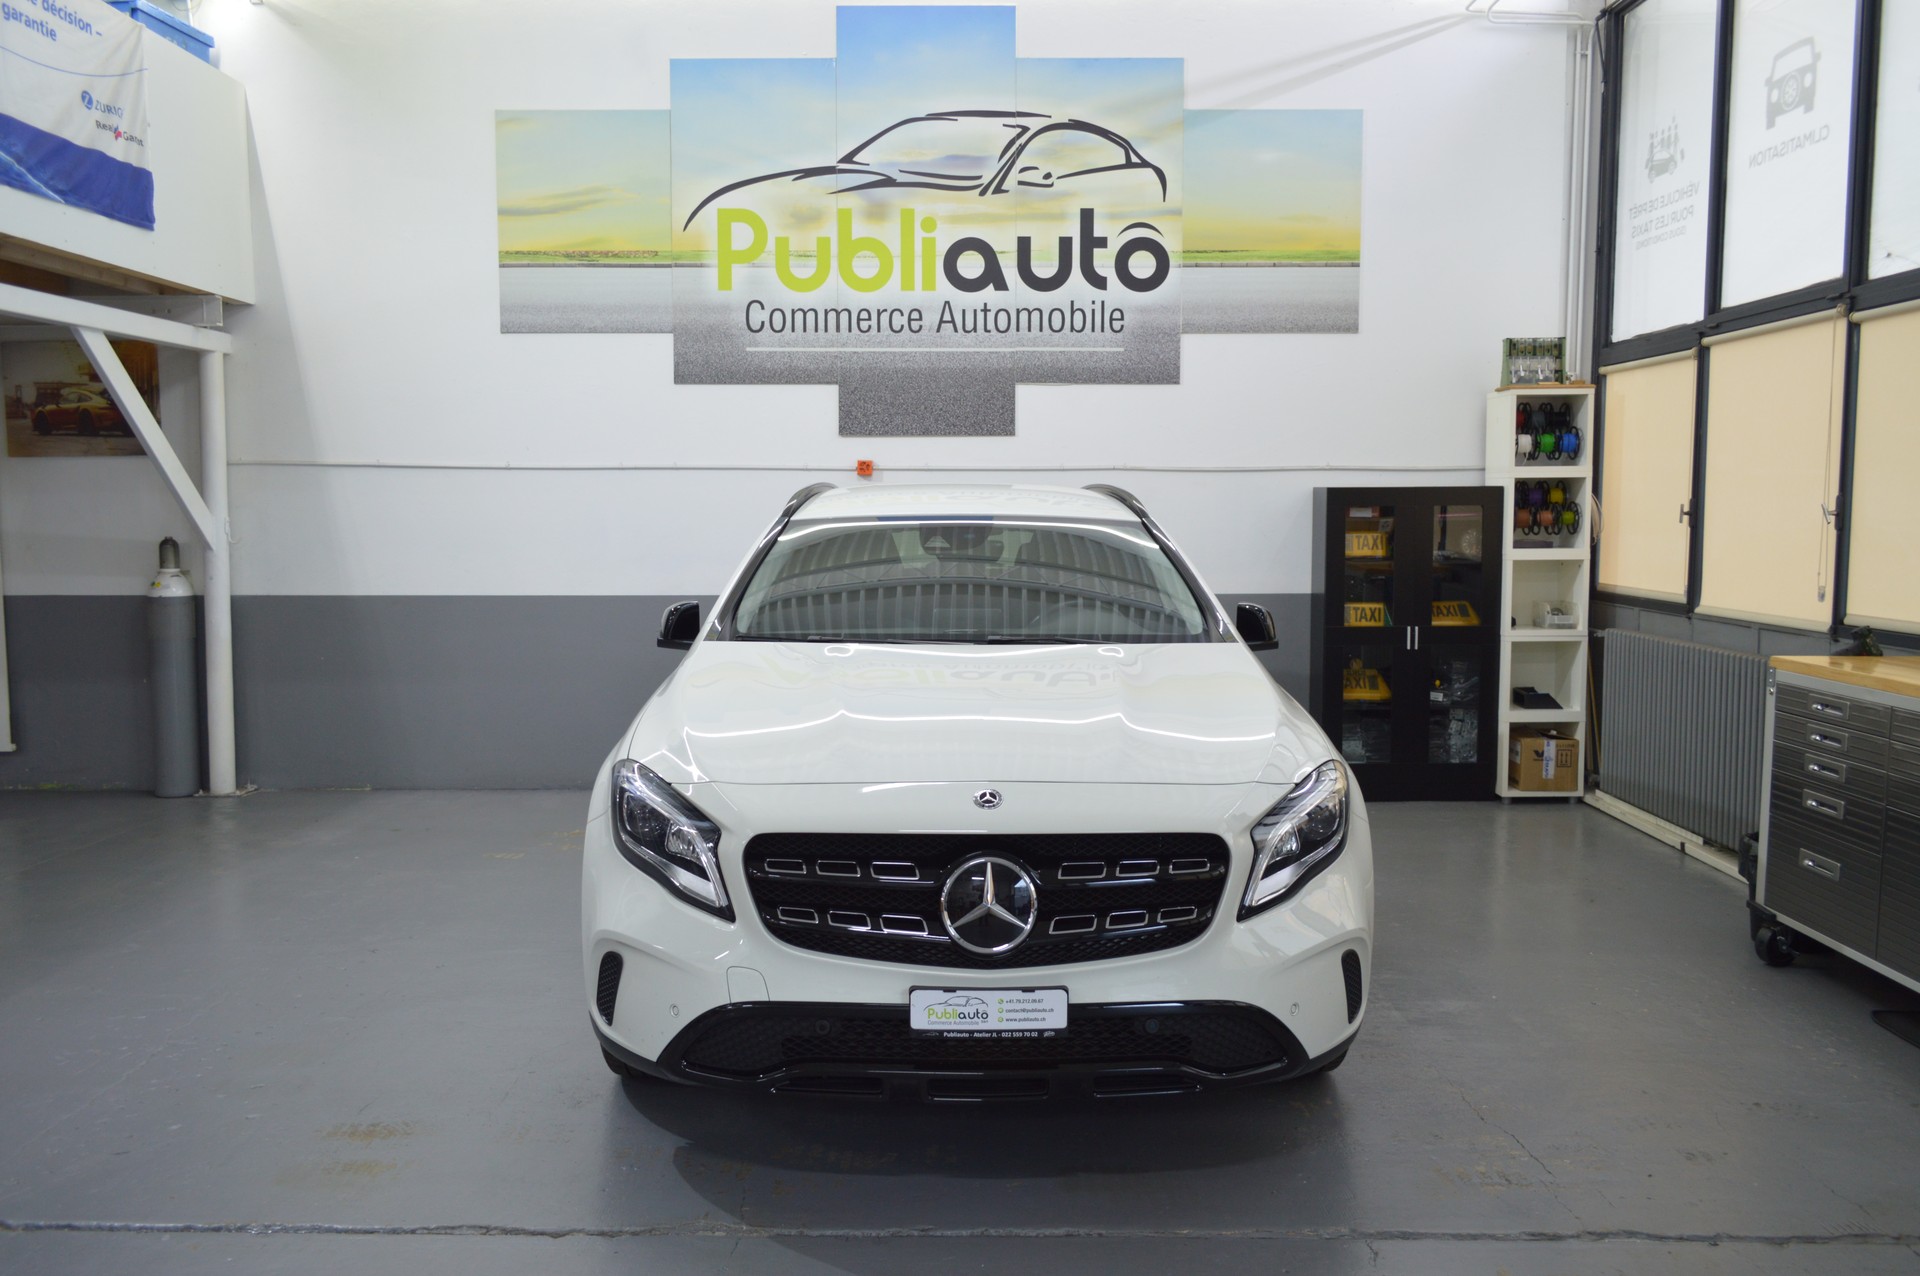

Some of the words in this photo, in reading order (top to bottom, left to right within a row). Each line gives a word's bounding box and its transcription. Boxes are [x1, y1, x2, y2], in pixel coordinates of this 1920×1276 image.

[1, 2, 57, 42] garantie
[745, 299, 923, 334] Commerce
[936, 299, 1126, 334] Automobile
[1355, 534, 1384, 551] TAXI
[1352, 606, 1382, 623] TAXI
